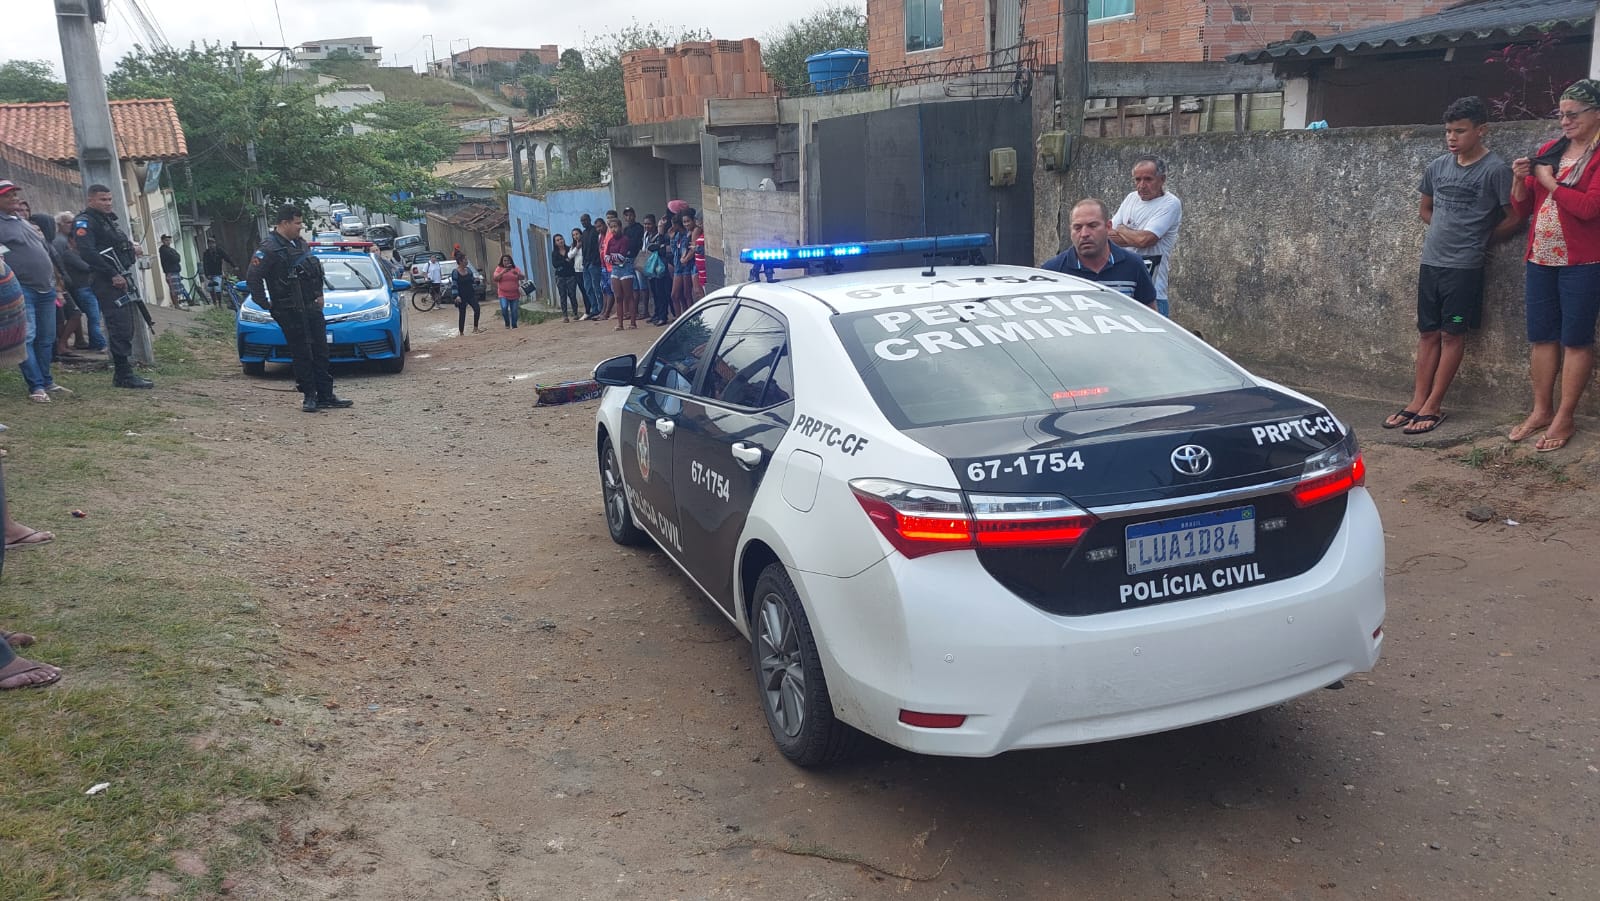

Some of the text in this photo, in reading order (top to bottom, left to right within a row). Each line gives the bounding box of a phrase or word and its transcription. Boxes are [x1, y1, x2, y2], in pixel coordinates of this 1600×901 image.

[873, 294, 1113, 333] PERICIA
[874, 314, 1167, 361] CRIMINAL
[793, 413, 868, 456] PRPTC-CF
[1251, 416, 1335, 446] PRPTC-CF
[691, 460, 730, 502] 67-1754
[967, 451, 1085, 482] 67-1754
[658, 511, 682, 552] CIVIL
[1139, 524, 1240, 566] LUA1D84
[1119, 562, 1266, 604] POLÍCIA CIVIL
